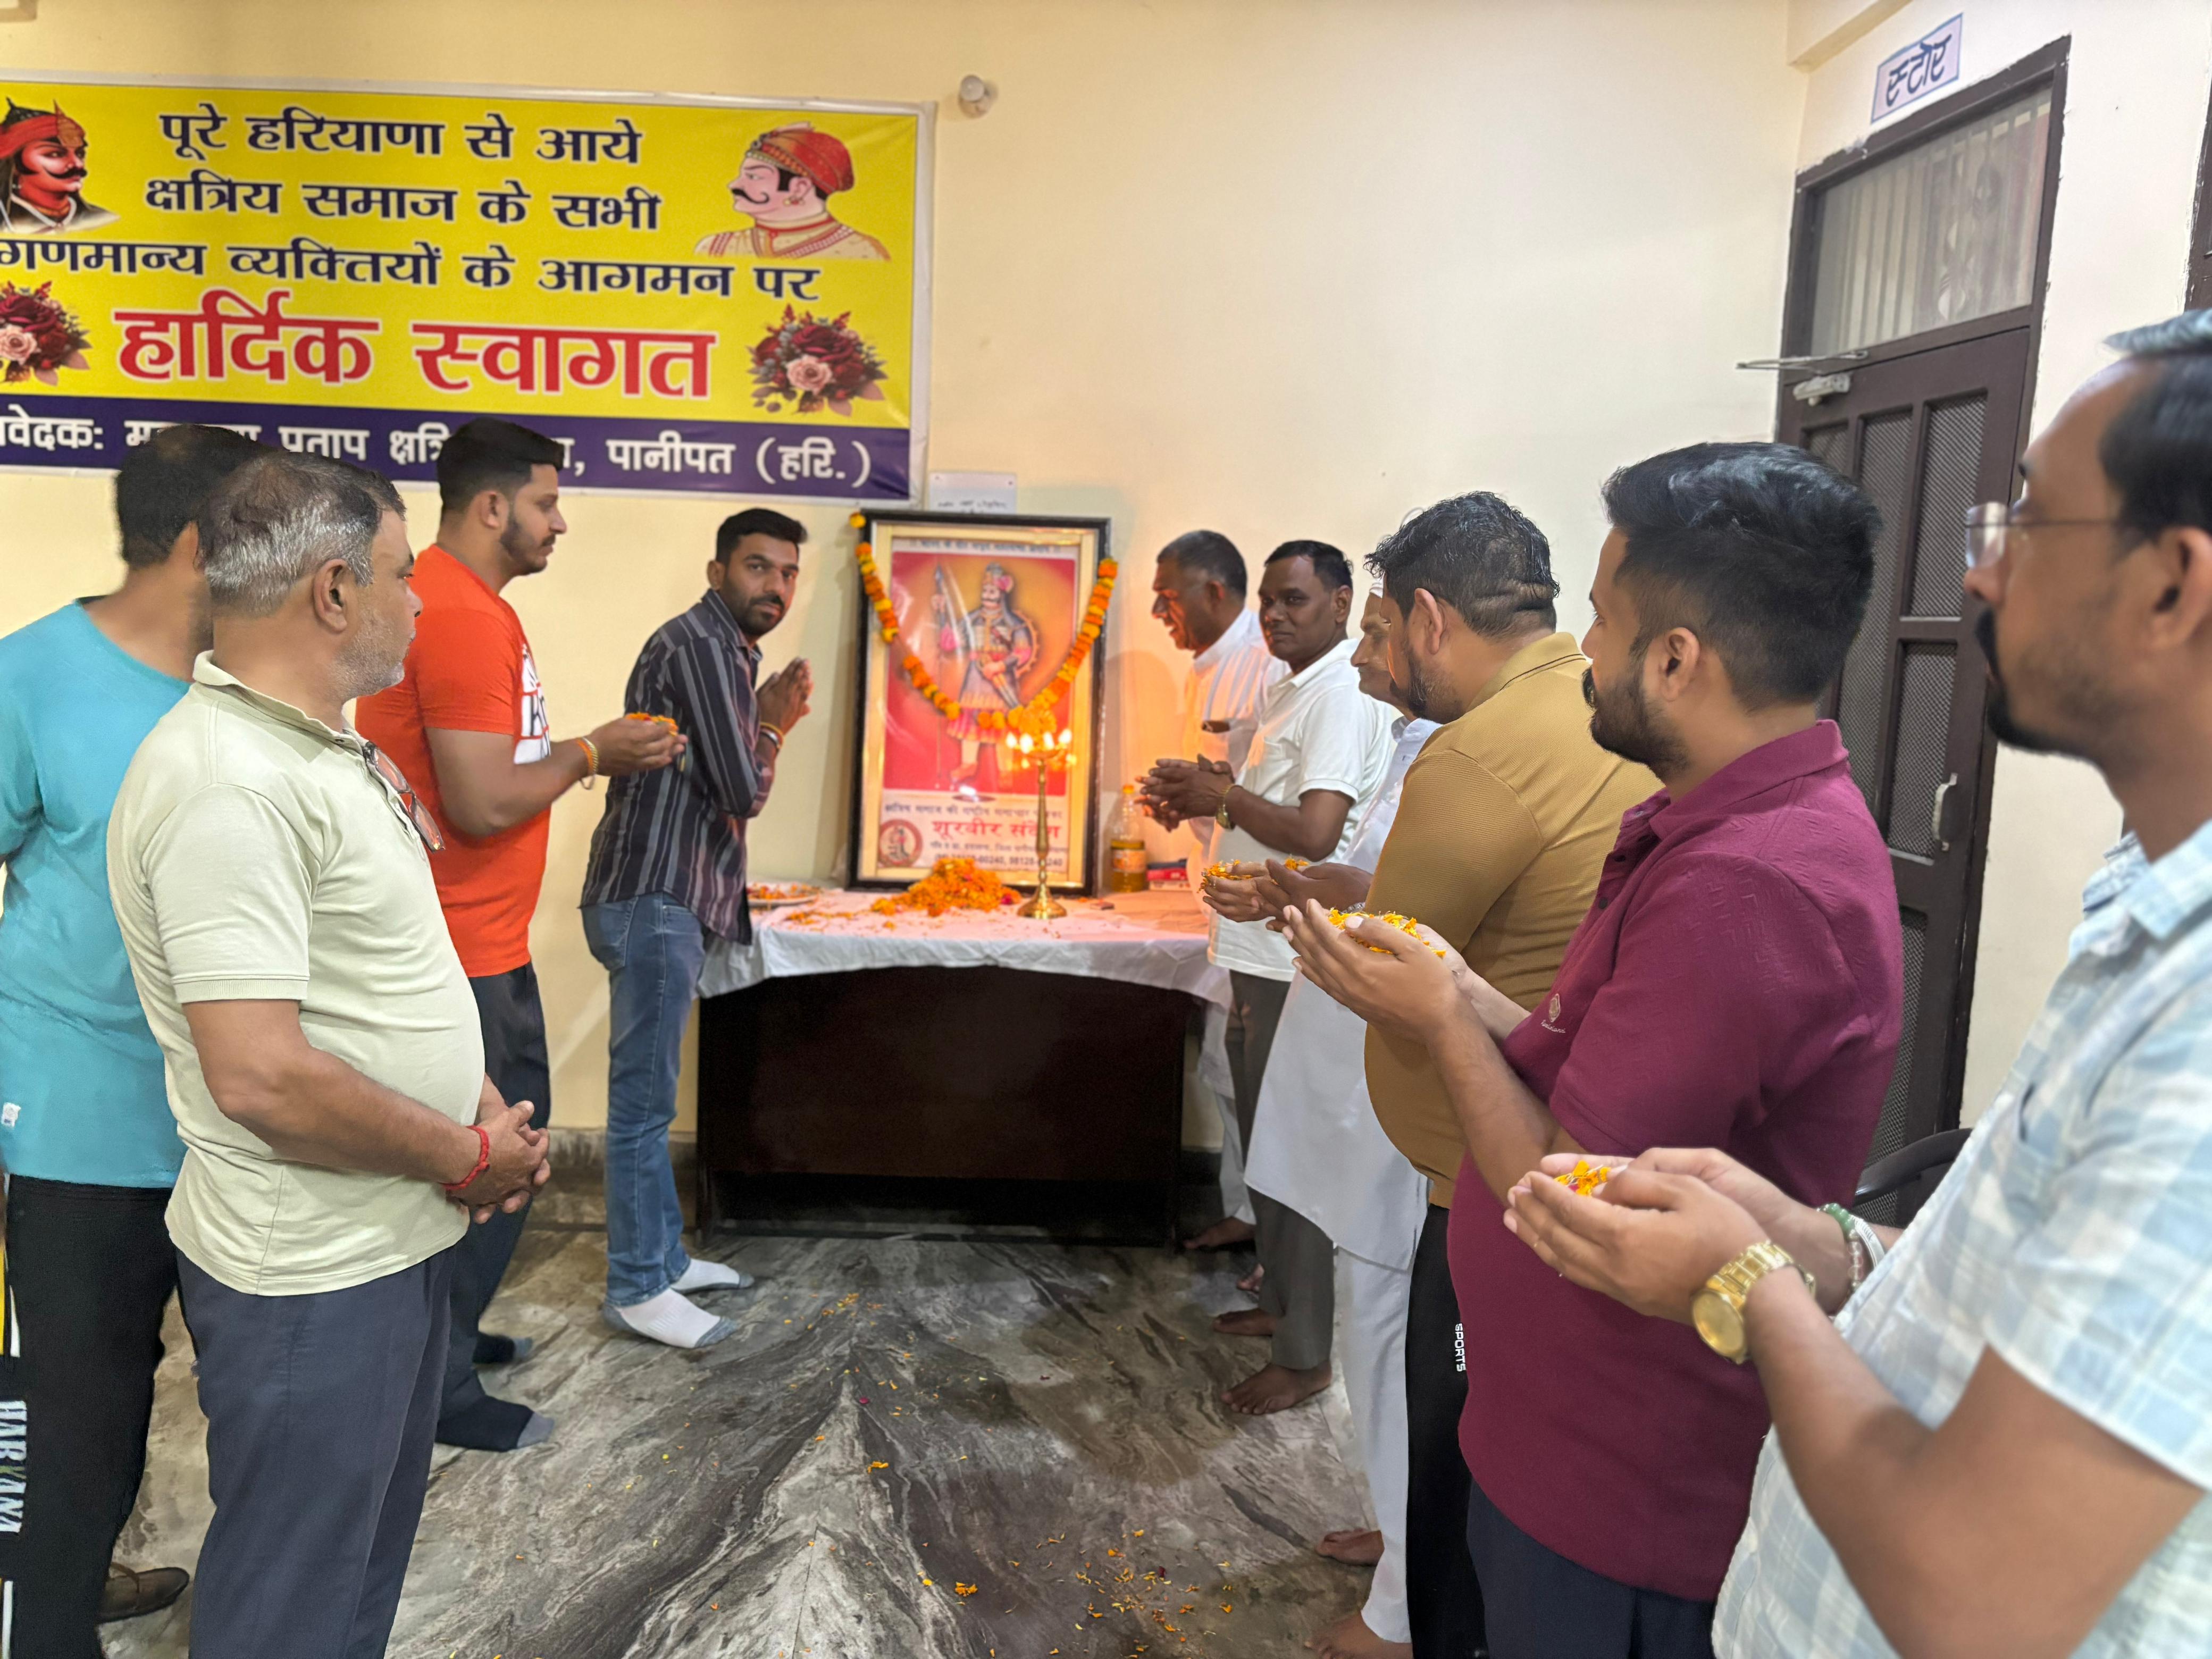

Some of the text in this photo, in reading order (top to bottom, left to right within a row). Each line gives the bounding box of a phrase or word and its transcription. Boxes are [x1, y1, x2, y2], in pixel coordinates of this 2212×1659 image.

[1886, 33, 1952, 107] स्टोर
[160, 103, 643, 163] पूरे हरियाणा से आये
[146, 170, 661, 229] क्षत्रिय समाज के सभी
[0, 237, 820, 300] गणमान्य व्यक्तियों के आगमन पर
[113, 289, 717, 398] हार्दिक स्वागत
[606, 430, 735, 474] पानीपत
[1455, 1323, 1466, 1372] SPORTS
